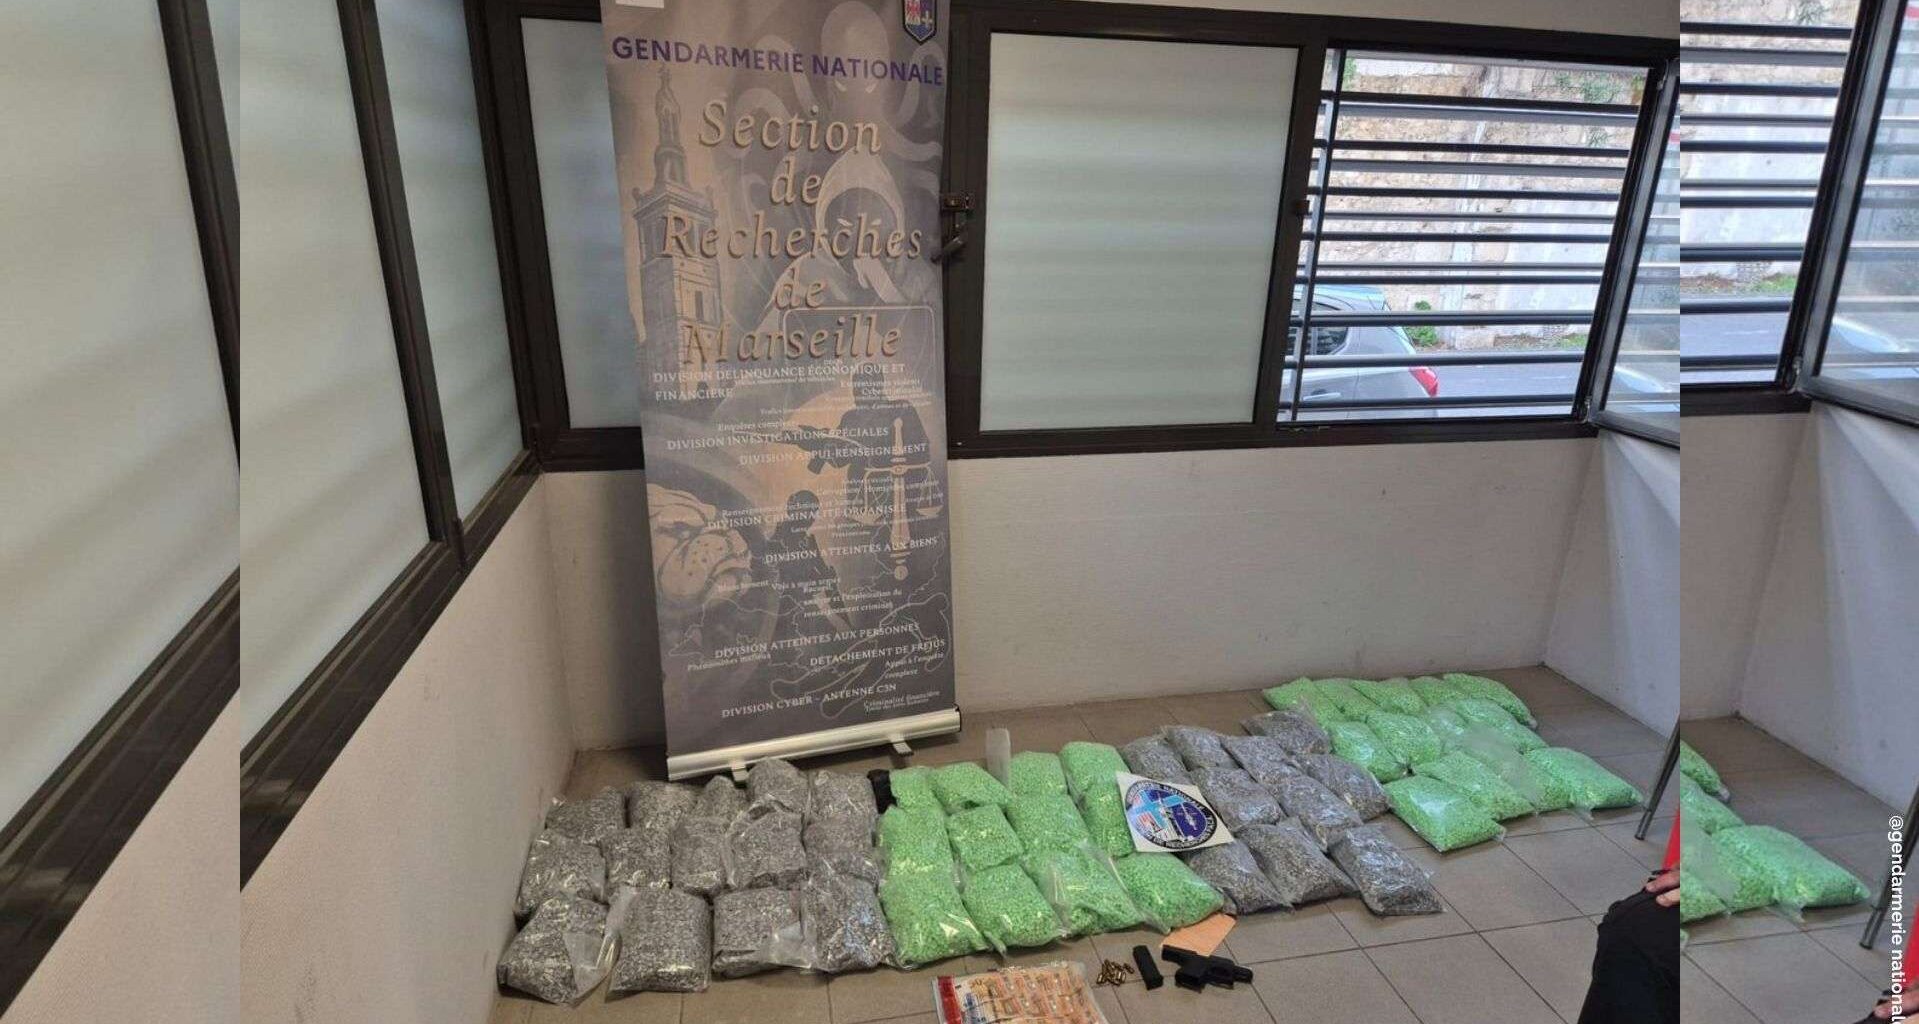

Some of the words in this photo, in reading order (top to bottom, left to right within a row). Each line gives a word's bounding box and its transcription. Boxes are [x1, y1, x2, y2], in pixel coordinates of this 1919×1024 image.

[612, 36, 804, 74] GENDARMERIE
[811, 54, 943, 86] NATIONALE
[698, 99, 882, 155] Section
[771, 156, 821, 206] de
[662, 210, 923, 260] Recherches
[774, 267, 827, 310] de
[681, 314, 902, 364] Marseille
[653, 371, 713, 383] DIVISION
[892, 363, 906, 373] ET
[666, 438, 725, 451] DIVISION
[727, 430, 827, 446] INVESTIGATIONS
[739, 452, 793, 465] DIVISION
[707, 515, 761, 530] DIVISION
[765, 550, 817, 564] DIVISION
[909, 536, 938, 550] BIENS
[714, 643, 768, 659] DIVISION
[770, 634, 831, 650] ATTEINTES
[833, 631, 857, 643] AUX
[859, 623, 920, 638] PERSONNES
[895, 646, 910, 655] DE
[721, 702, 774, 718] DIVISION
[776, 695, 813, 709] CYBER
[823, 686, 875, 702] ANTENNE
[876, 684, 897, 694] C3N
